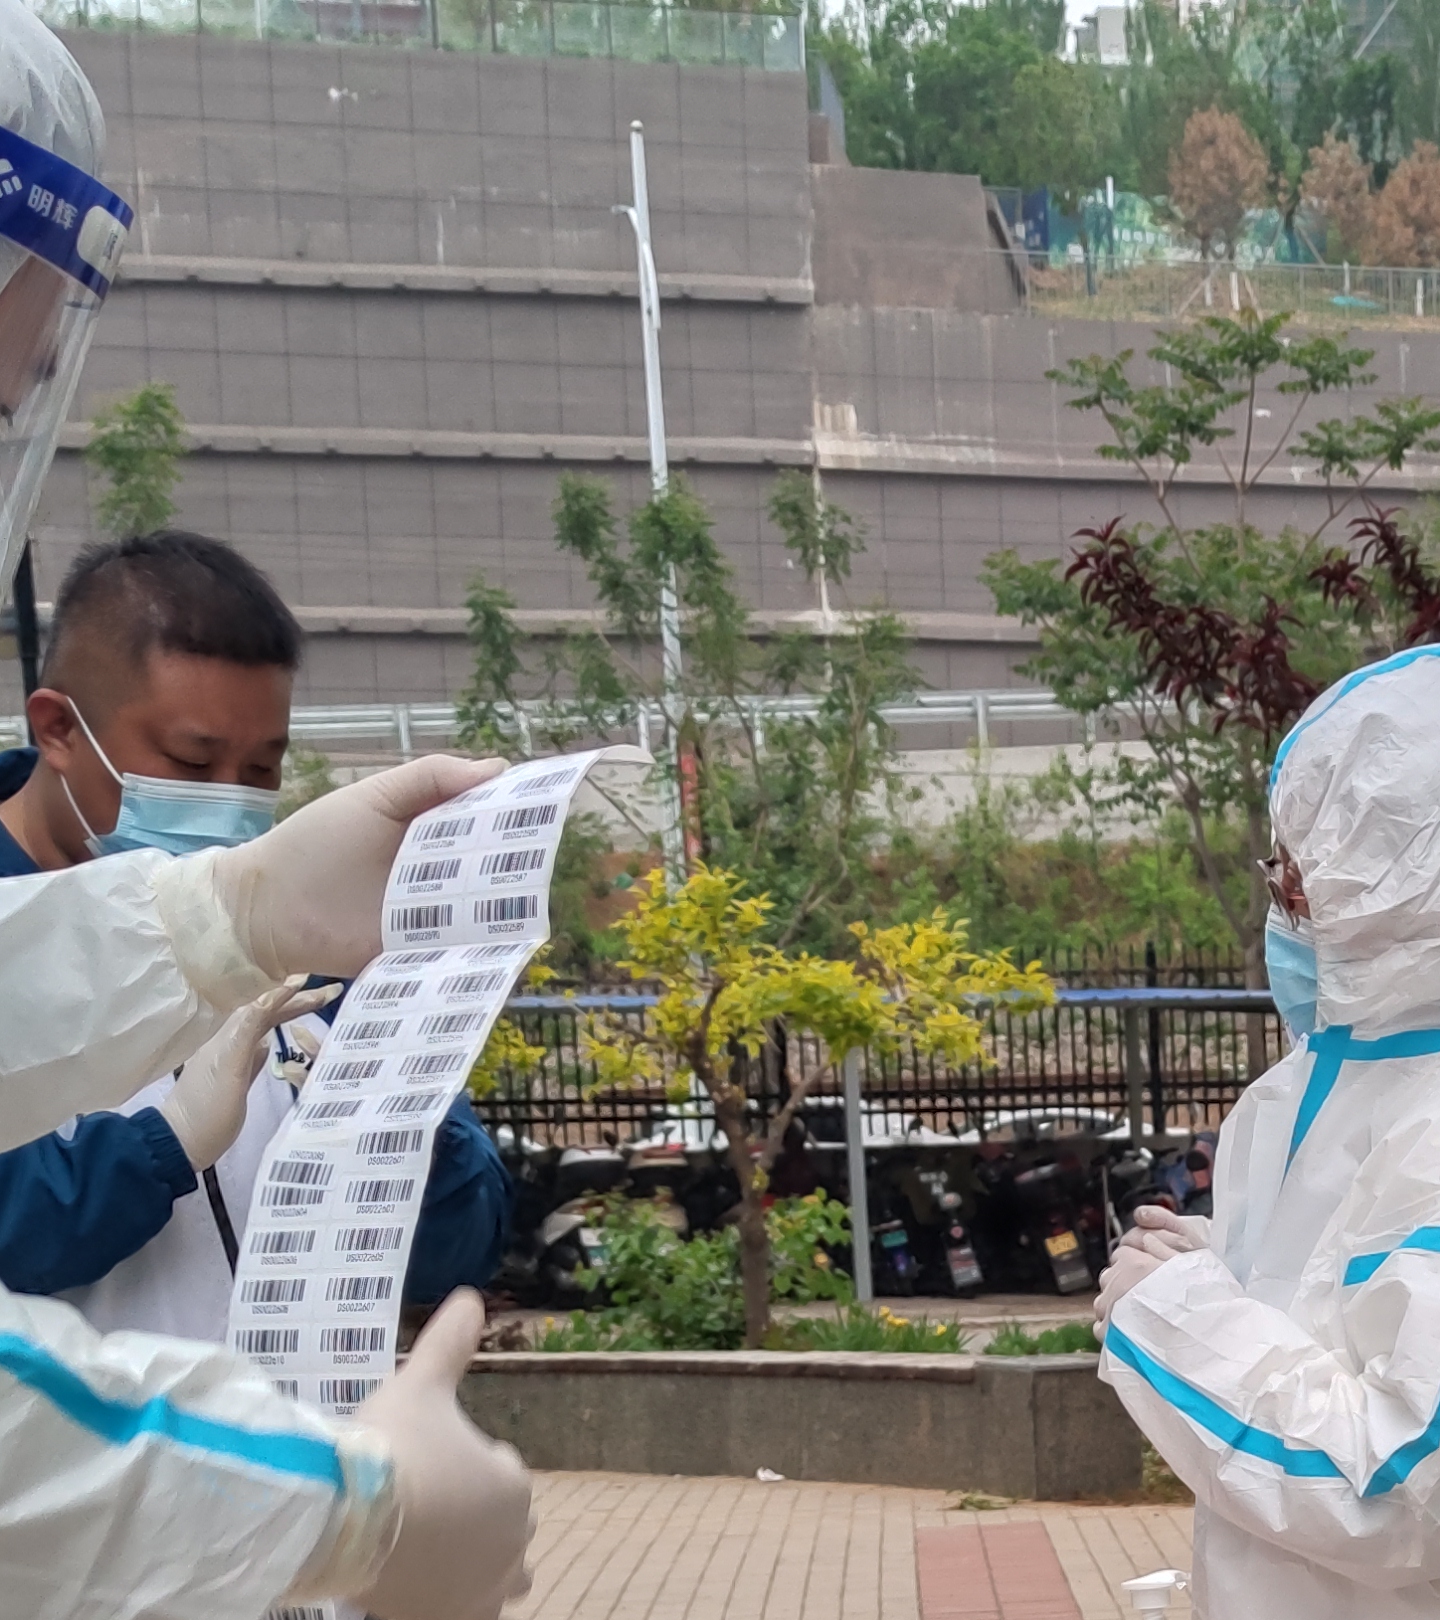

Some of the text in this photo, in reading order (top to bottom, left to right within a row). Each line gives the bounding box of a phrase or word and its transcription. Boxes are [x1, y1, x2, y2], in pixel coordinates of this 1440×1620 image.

[26, 183, 79, 231] 明辉
[367, 1155, 406, 1166] DS0022601
[355, 1203, 396, 1215] DS0022603
[345, 1251, 385, 1263] DS0022605
[336, 1302, 376, 1313] DS0022607
[332, 1353, 371, 1365] DS0022609
